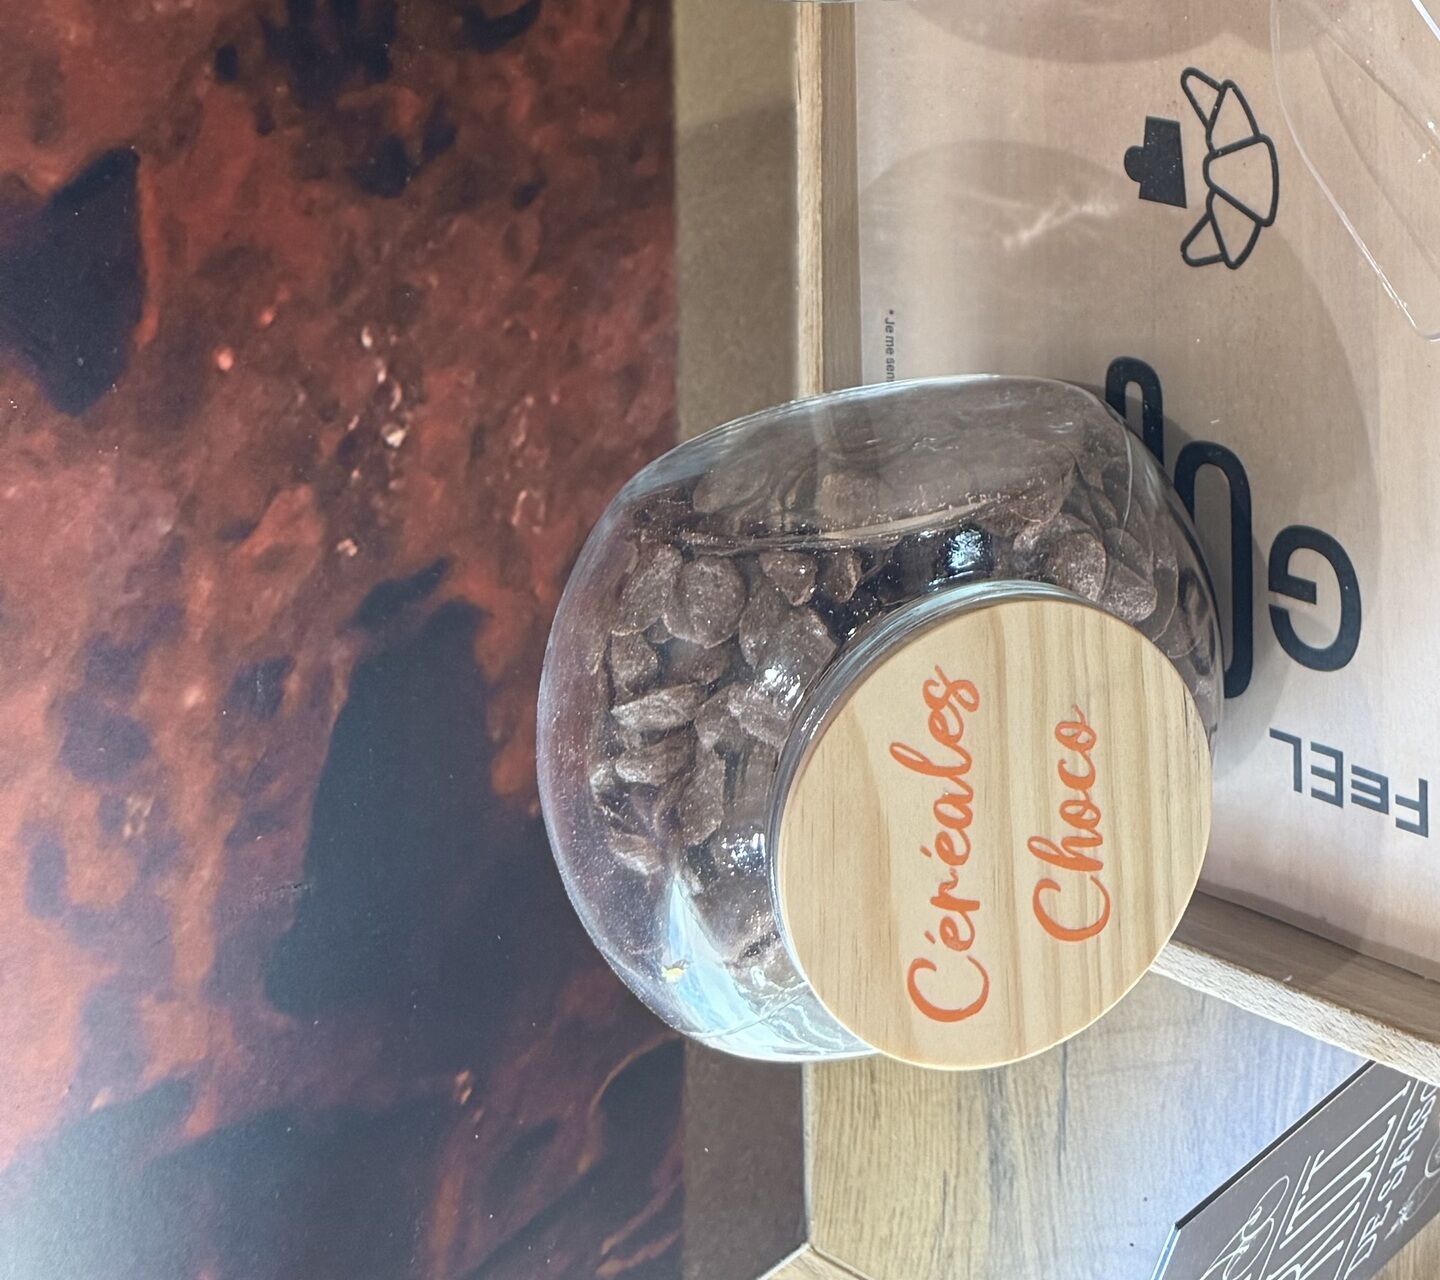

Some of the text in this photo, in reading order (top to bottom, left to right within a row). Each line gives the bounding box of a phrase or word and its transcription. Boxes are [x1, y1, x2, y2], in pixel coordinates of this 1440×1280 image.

[888, 665, 990, 1023] Céréales
[1026, 703, 1111, 943] Choco
[1269, 728, 1430, 838] FEEL
